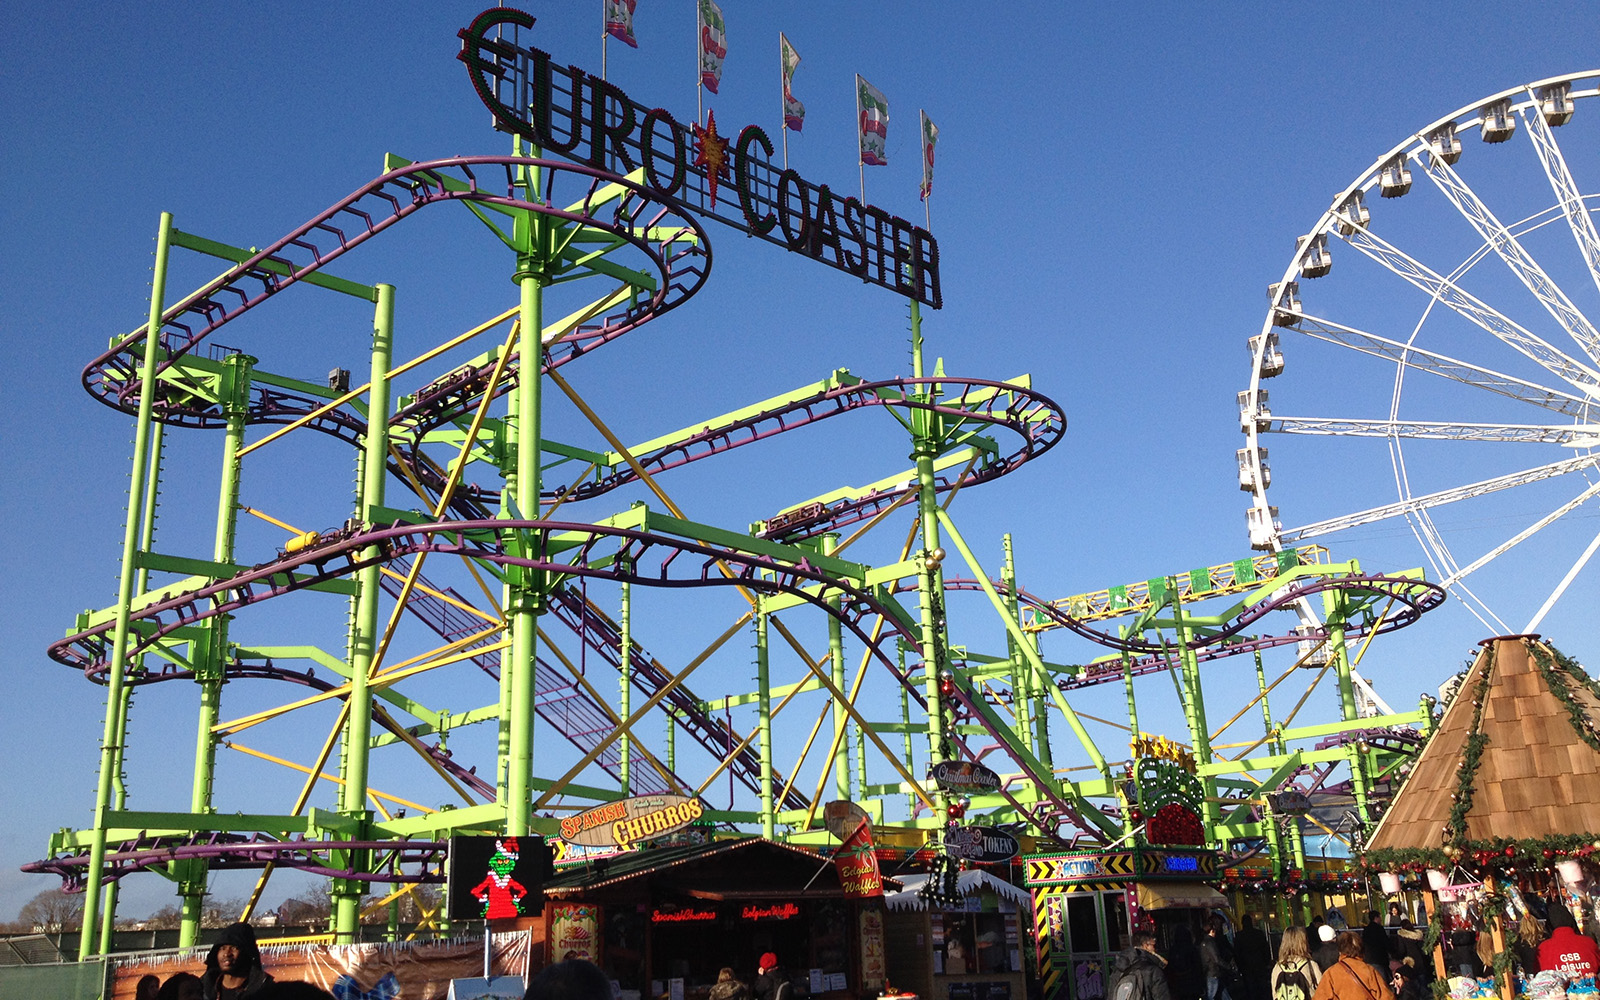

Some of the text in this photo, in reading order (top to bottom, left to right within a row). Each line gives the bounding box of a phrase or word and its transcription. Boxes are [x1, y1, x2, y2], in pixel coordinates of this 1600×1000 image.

[735, 124, 942, 310] COASTER
[938, 764, 997, 787] Christmas Coaster
[561, 801, 627, 839] SPANISH
[612, 797, 702, 845] CHURROS
[983, 835, 1013, 854] TOKENS
[842, 866, 875, 877] Belgian
[1063, 860, 1096, 875] ACTION
[842, 878, 880, 894] Waffles
[742, 905, 771, 921] Belgian
[558, 939, 592, 949] Churros
[1560, 952, 1581, 963] GSB
[1555, 962, 1591, 972] Leisure
